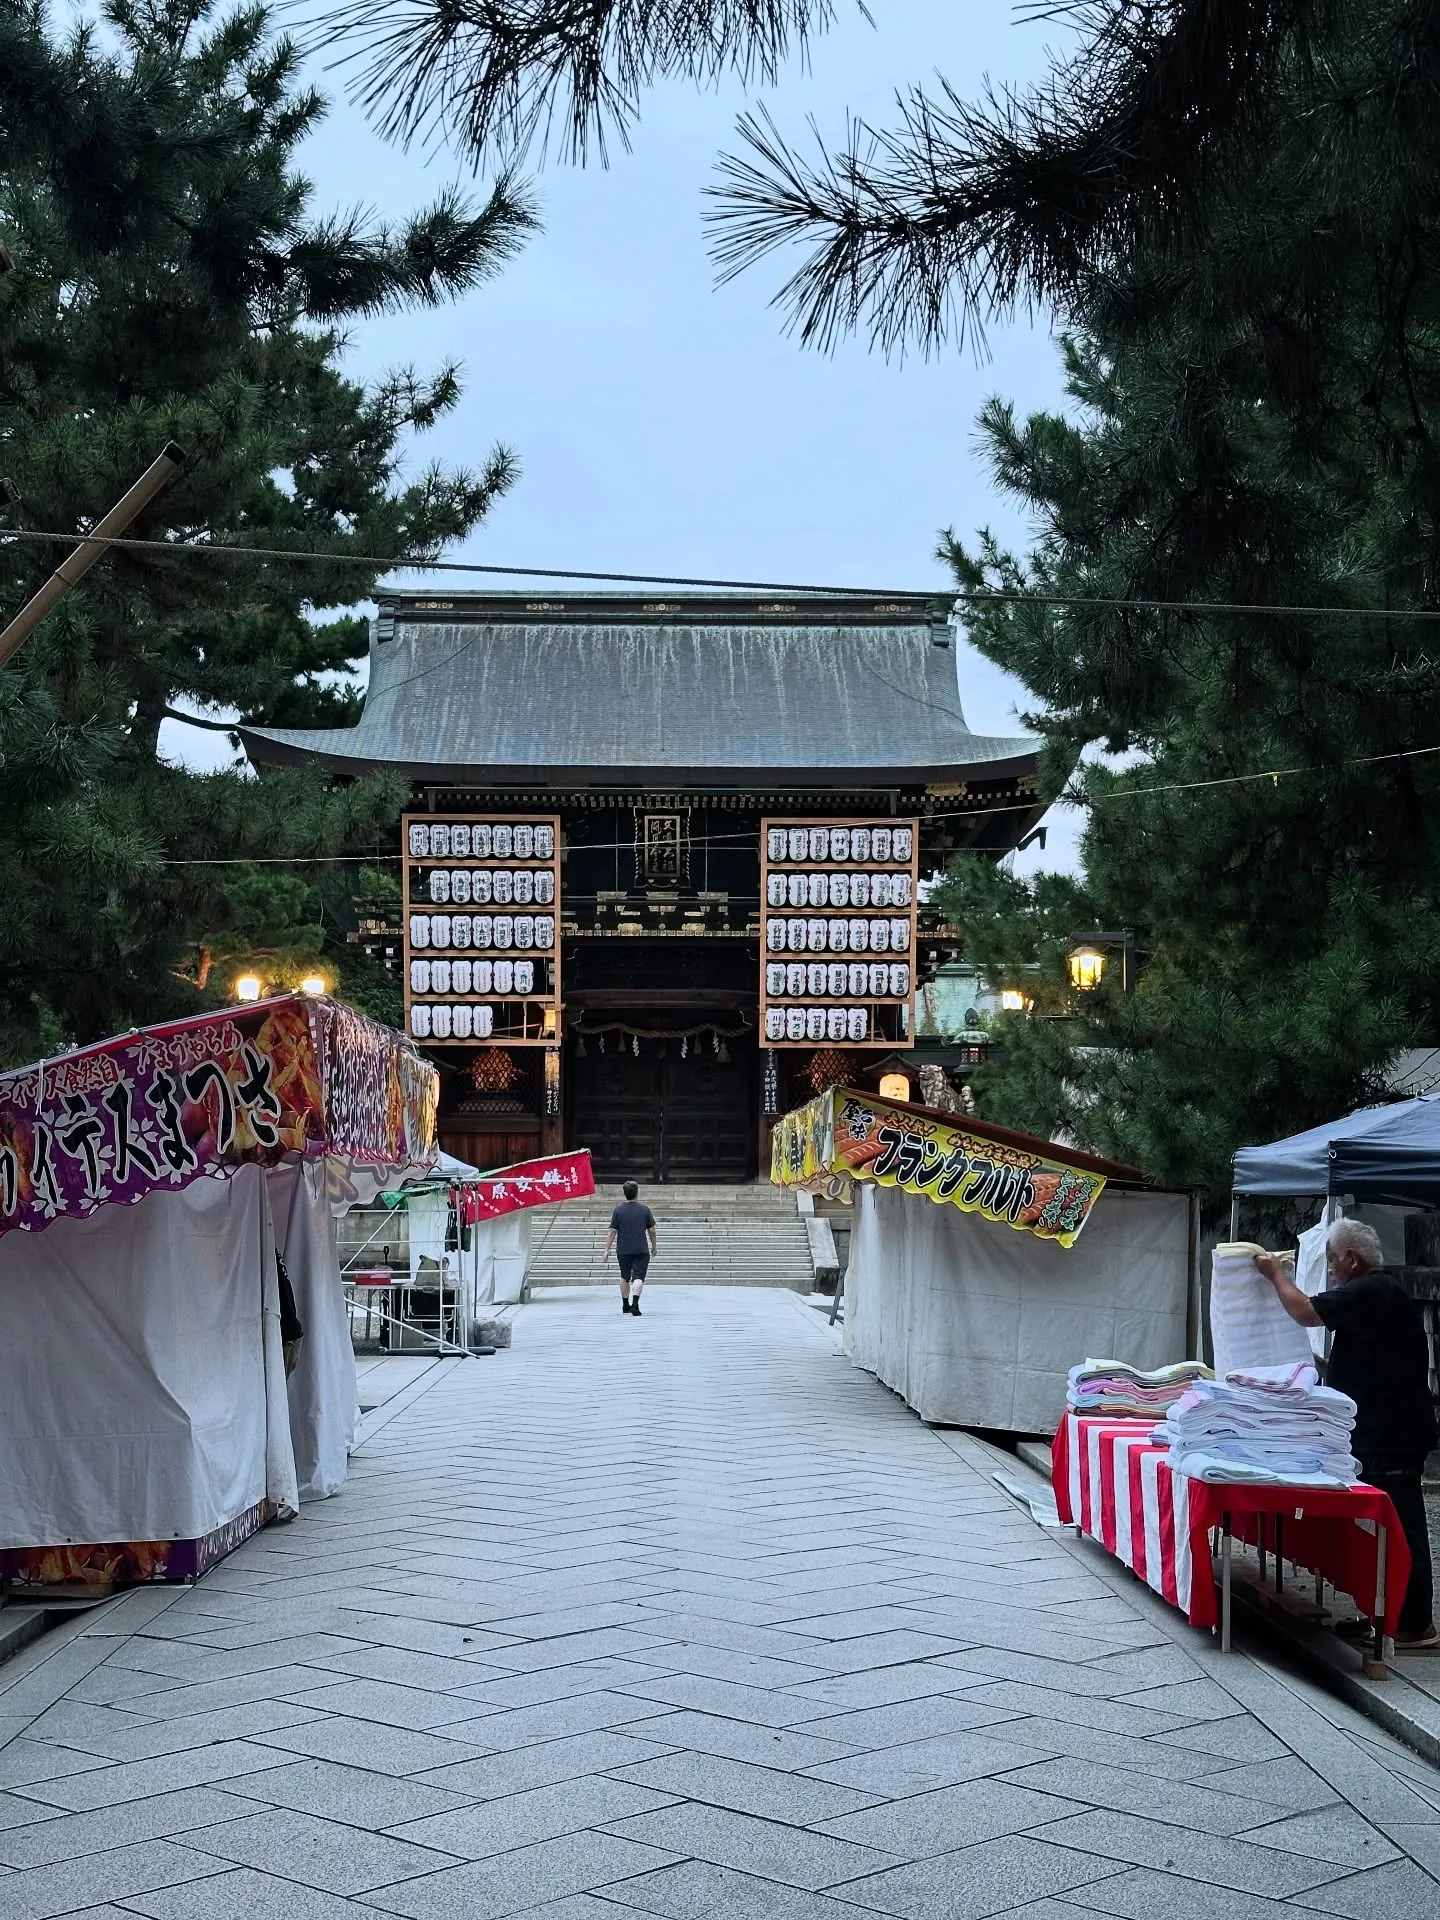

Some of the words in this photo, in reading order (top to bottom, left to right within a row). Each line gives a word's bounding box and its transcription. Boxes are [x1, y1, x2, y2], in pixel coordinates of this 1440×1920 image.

[873, 1126, 1035, 1223] フランクフルト
